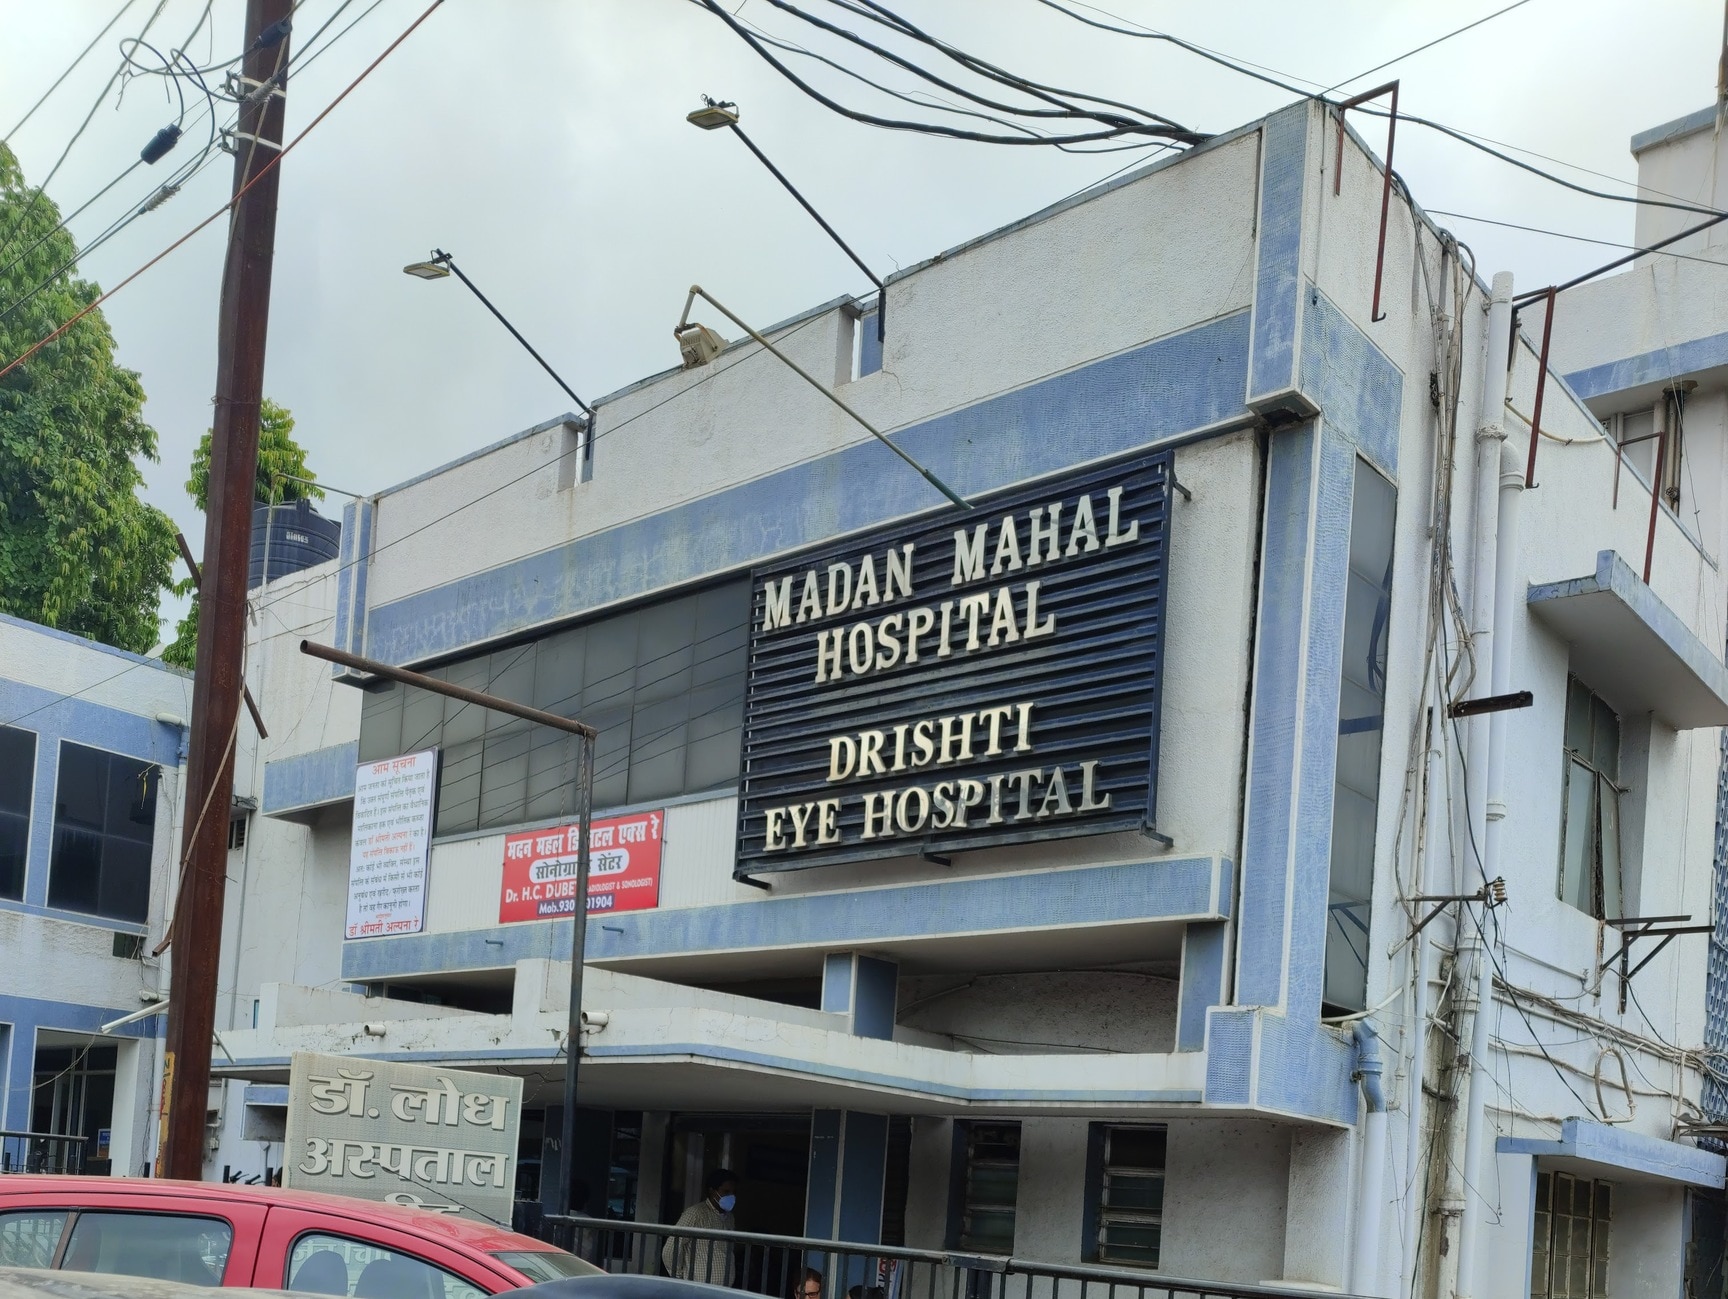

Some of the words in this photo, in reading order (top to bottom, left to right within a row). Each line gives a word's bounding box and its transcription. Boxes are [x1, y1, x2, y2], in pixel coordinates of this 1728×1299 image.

[762, 542, 916, 631] MADAN
[951, 485, 1141, 586] MAHAL
[814, 580, 1058, 684] HOSPITAL
[372, 762, 390, 775] आम
[392, 756, 417, 774] सूचना
[826, 701, 1035, 783] DRISHTI
[763, 797, 843, 852] EYE
[860, 760, 1112, 841] HOSPITAL
[507, 839, 533, 860] मदन
[536, 834, 564, 856] महल
[650, 814, 660, 840] रे
[598, 853, 623, 871] सेंटर
[505, 889, 519, 904] Dr.
[522, 886, 543, 901] H.C.
[546, 881, 577, 899] DUBE
[360, 919, 383, 935] श्रीमती
[307, 1068, 380, 1118] डॉ.
[389, 1076, 510, 1131] लोध
[299, 1137, 509, 1188] अस्पताल
